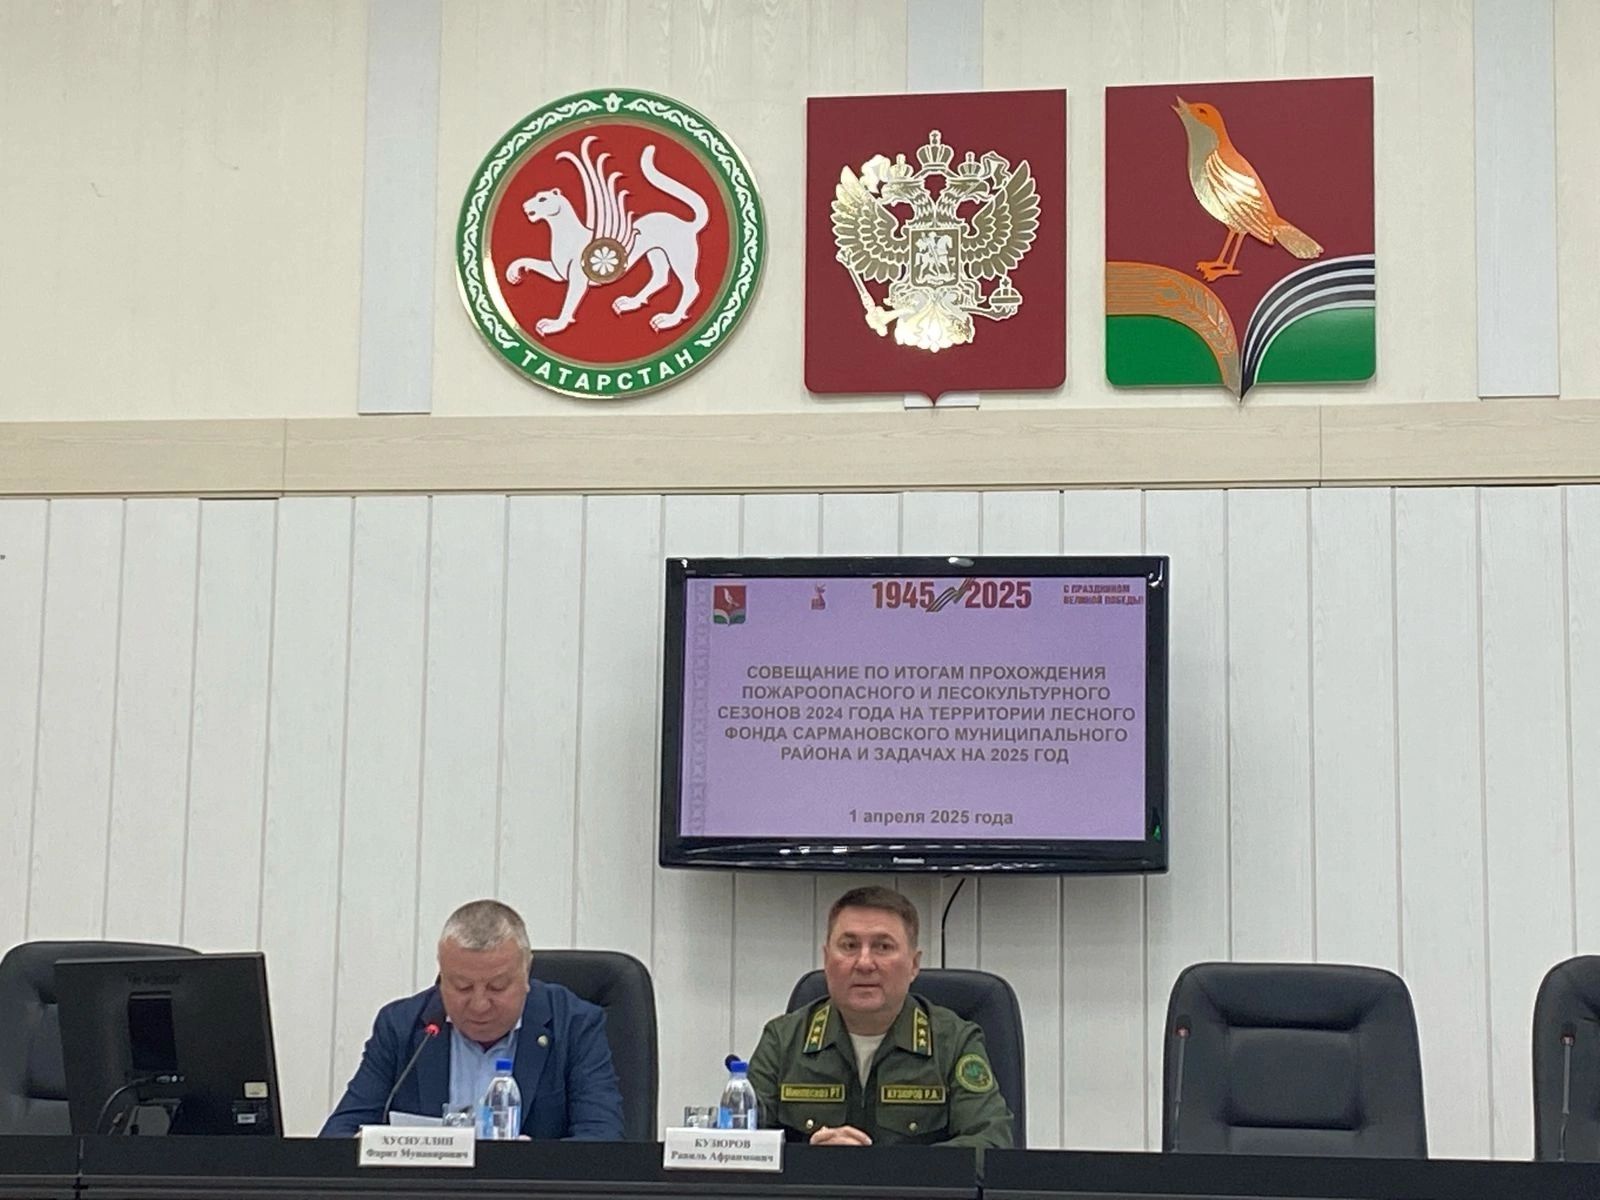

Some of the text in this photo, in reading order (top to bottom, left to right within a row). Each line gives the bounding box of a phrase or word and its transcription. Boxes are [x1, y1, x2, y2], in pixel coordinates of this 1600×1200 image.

[520, 348, 695, 391] ТАТАРСТАН
[872, 581, 1032, 609] 1945 2025
[747, 665, 1106, 682] СОВЕЩАНИЕ ПО ИТОГАМ ПРОХОЖДЕНИЯ
[742, 685, 1111, 701] ПОЖАРООПАСНОГО И ЛЕСОКУЛЬТУРНОГО
[718, 706, 1136, 723] СЕЗОНОВ 2024 ГОДА НА ТЕРРИТОРИИ ЛЕСНОГО
[724, 726, 1128, 743] ФОНДА САРМАНОВСКОГО МУНИЦИПАЛЬНОГО
[781, 745, 1070, 764] РАЙОНА И ЗАДАЧАХ НА 2025 ГОД
[849, 809, 1013, 827] 1 апреля 2025 года
[382, 1136, 454, 1146] ХУСНУЛЛИН
[694, 1138, 751, 1149] КУЗЮРОВ
